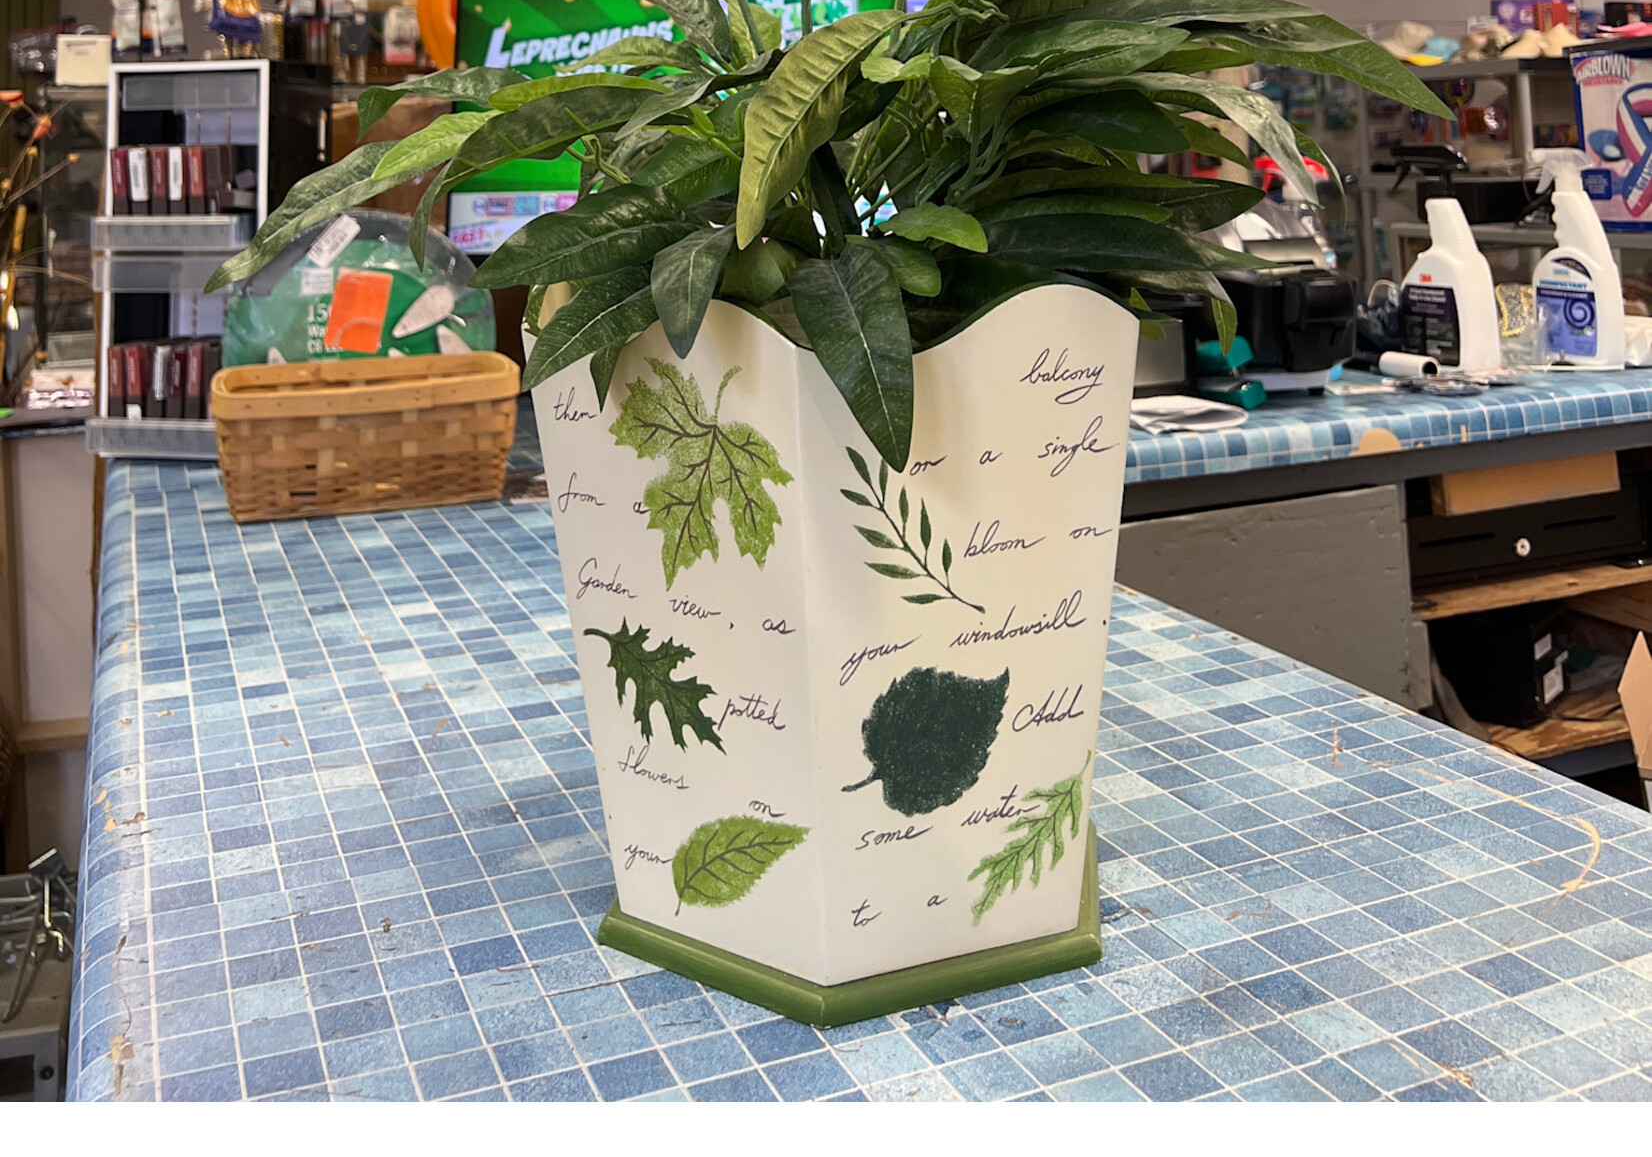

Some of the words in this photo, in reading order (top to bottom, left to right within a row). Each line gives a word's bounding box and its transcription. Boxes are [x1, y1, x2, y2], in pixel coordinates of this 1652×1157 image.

[1020, 348, 1104, 404] balcony
[553, 387, 597, 422] them
[979, 450, 1003, 465] a
[1038, 415, 1114, 477] single
[558, 472, 605, 513] from
[633, 500, 650, 514] a
[963, 520, 1046, 558] bloom
[1069, 528, 1113, 538] on
[576, 558, 638, 599] Garden
[762, 618, 796, 635] as
[840, 635, 922, 685] your
[717, 694, 786, 731] potted
[1012, 685, 1084, 732] Add
[618, 745, 690, 789] flowers
[749, 800, 786, 818] on
[855, 825, 934, 851] some
[961, 784, 1041, 827] water
[624, 844, 674, 871] your
[851, 898, 883, 928] to
[926, 894, 948, 908] a
